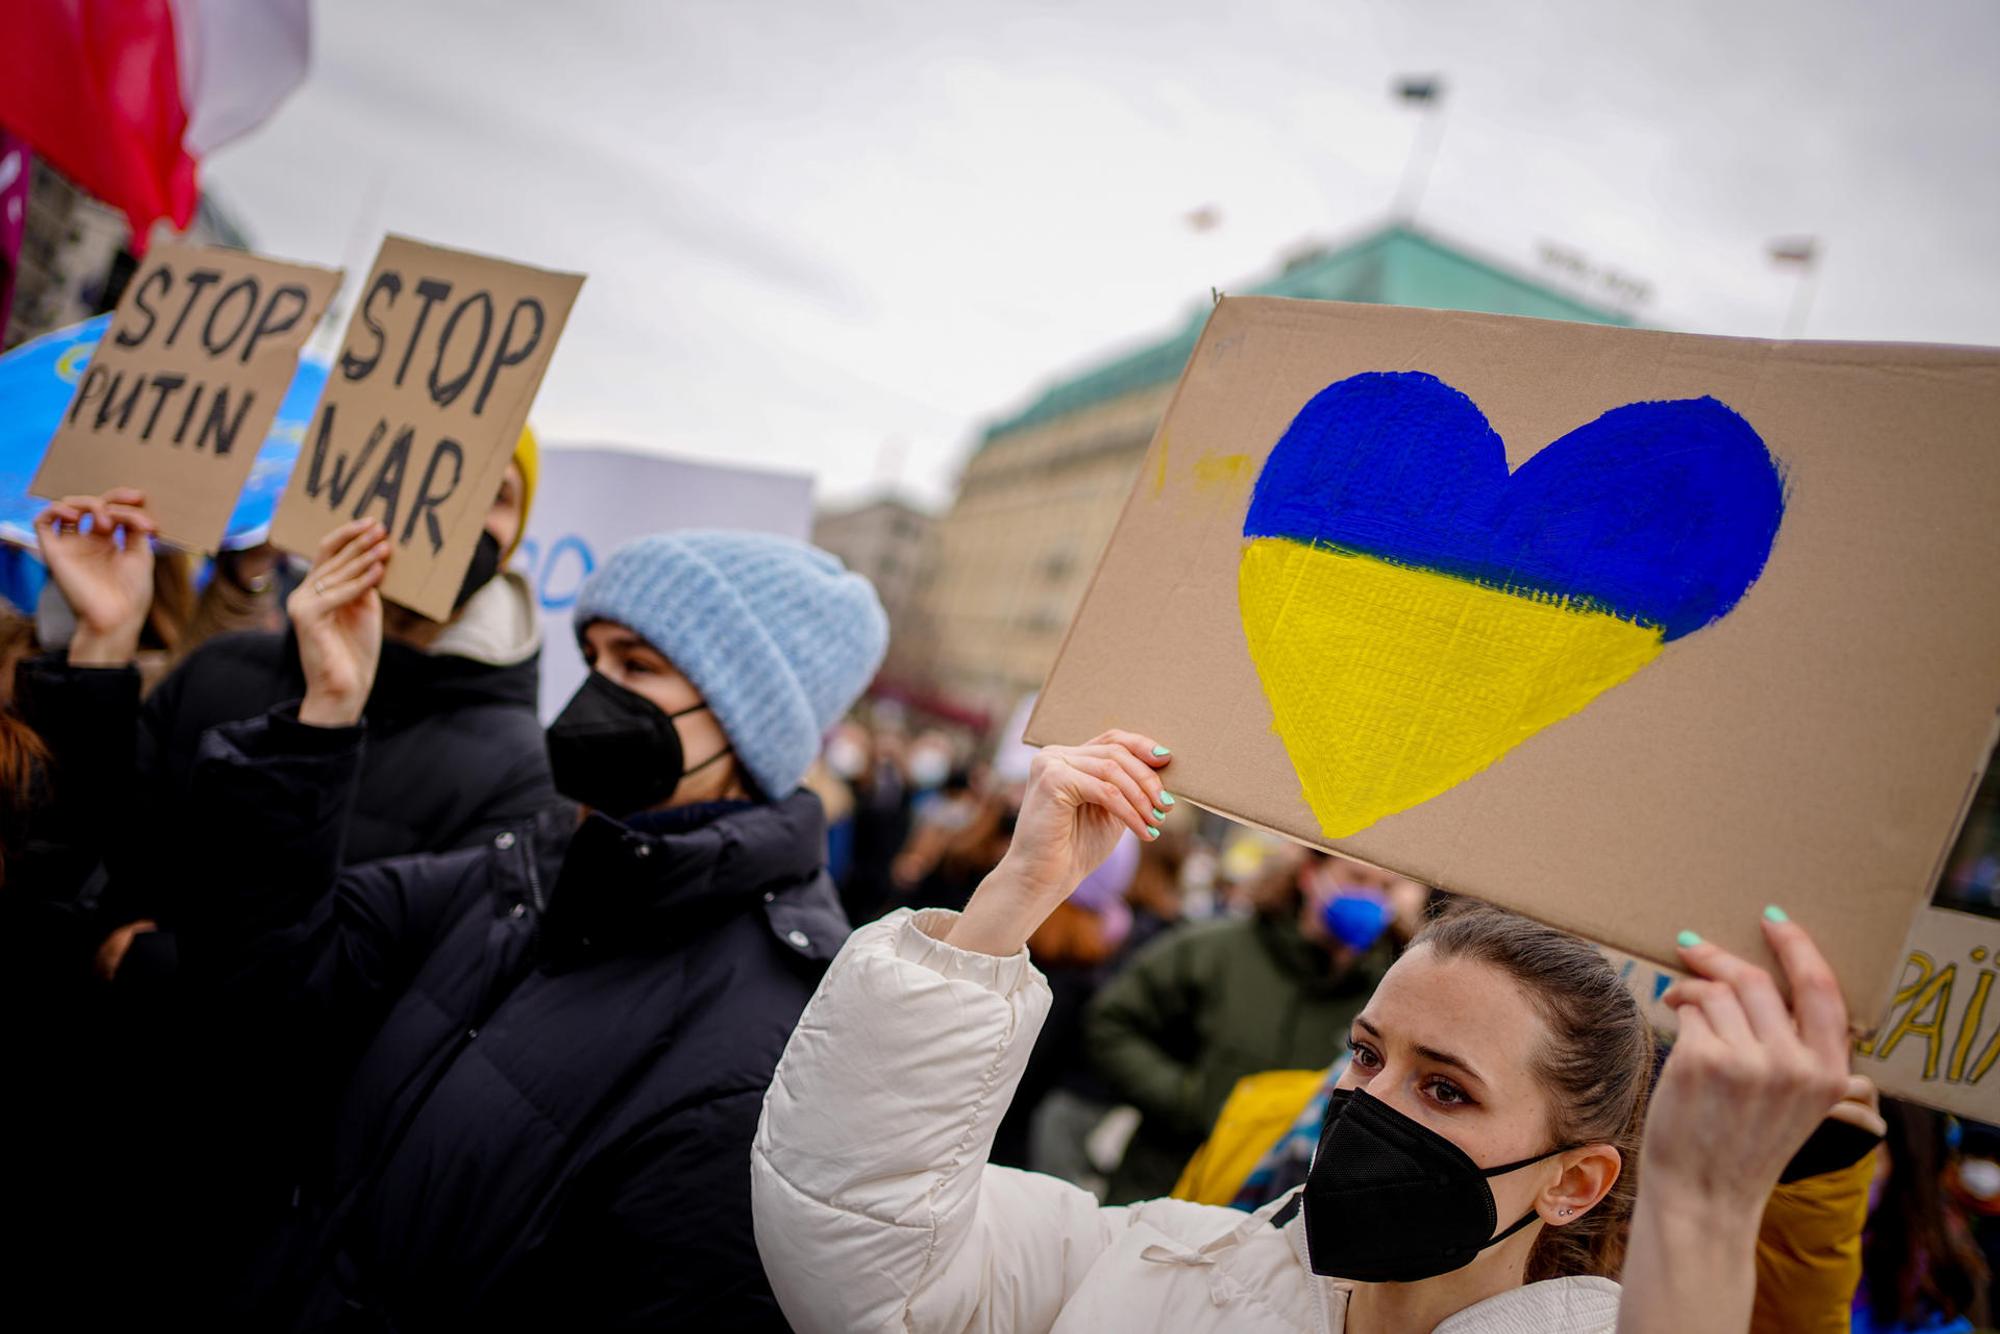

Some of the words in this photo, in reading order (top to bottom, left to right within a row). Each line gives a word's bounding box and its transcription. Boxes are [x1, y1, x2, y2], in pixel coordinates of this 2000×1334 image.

[116, 266, 309, 362] STOP
[341, 271, 546, 415] STOP
[69, 366, 256, 455] PUTIN
[305, 405, 463, 553] WAR
